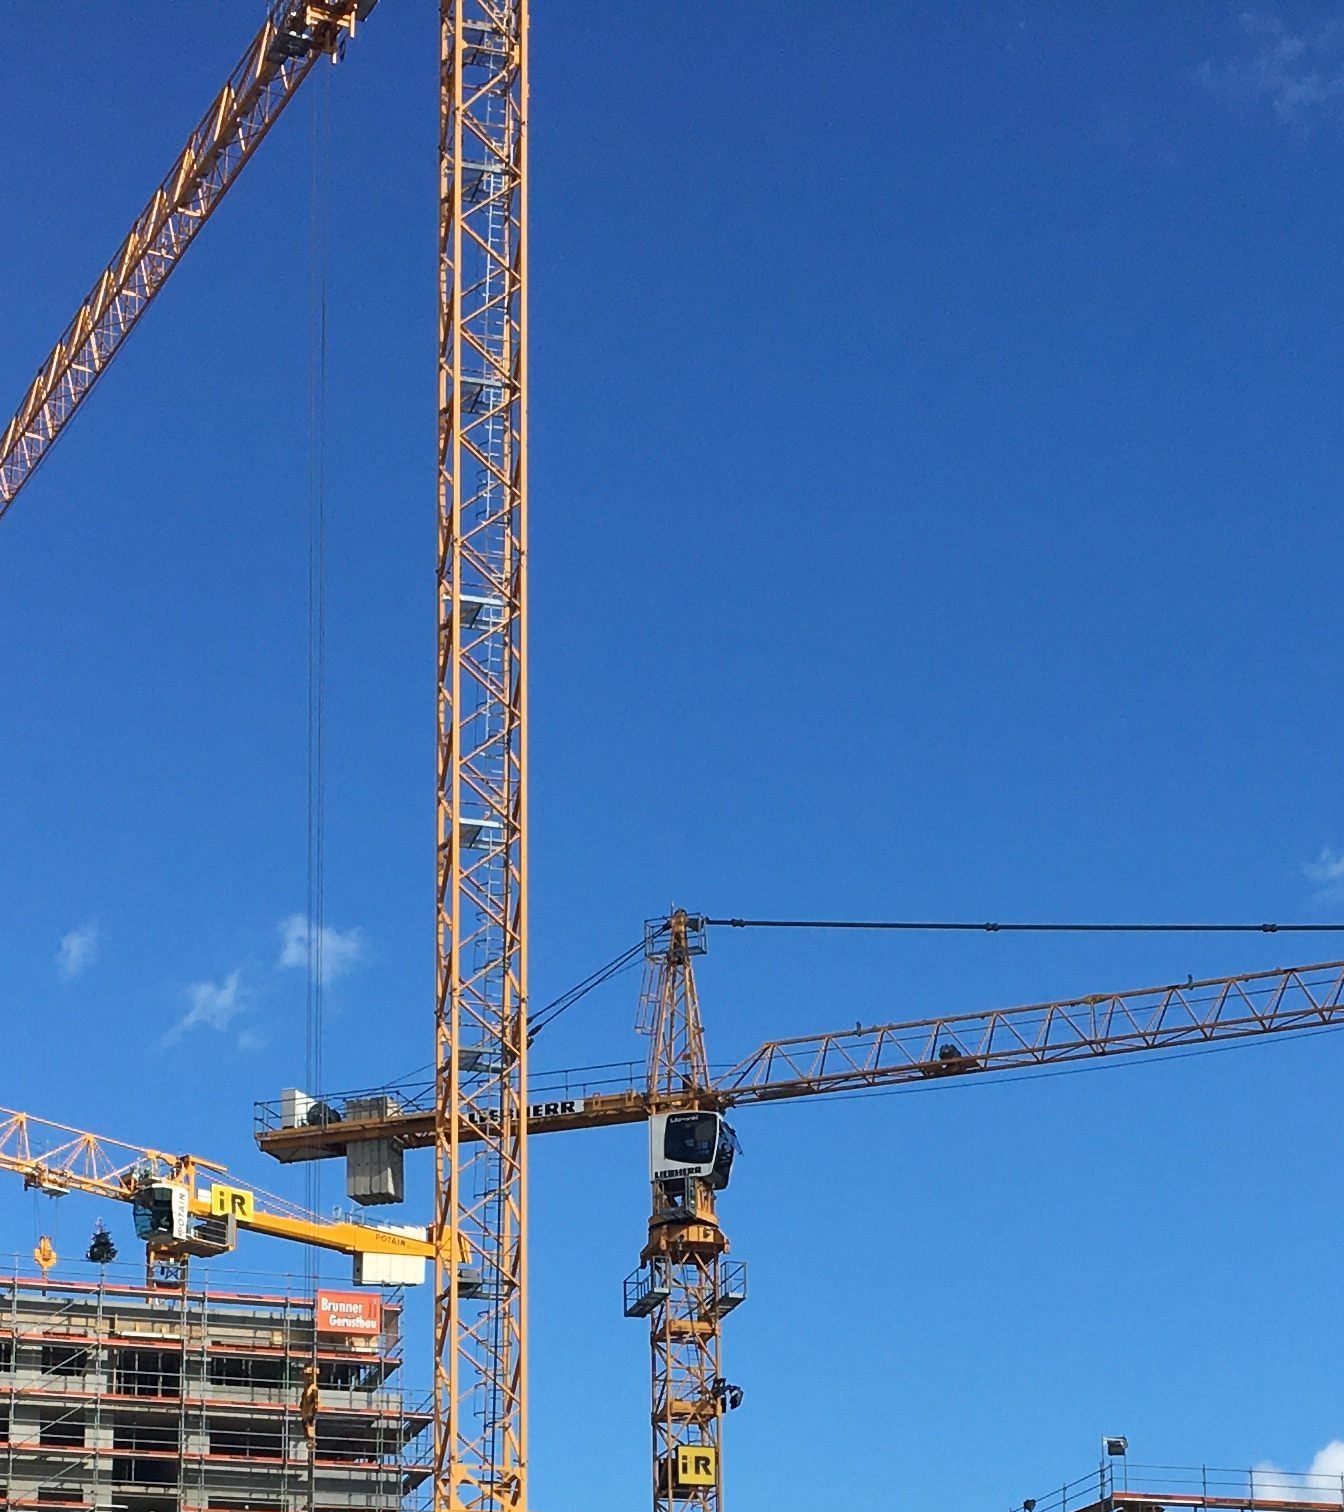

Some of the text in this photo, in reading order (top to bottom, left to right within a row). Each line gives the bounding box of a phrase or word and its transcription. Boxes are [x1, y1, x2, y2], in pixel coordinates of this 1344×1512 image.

[468, 1101, 575, 1123] LIEERR
[375, 1233, 406, 1247] POTAIN
[321, 1297, 364, 1314] Brunner
[329, 1314, 377, 1329] Gerüstbau
